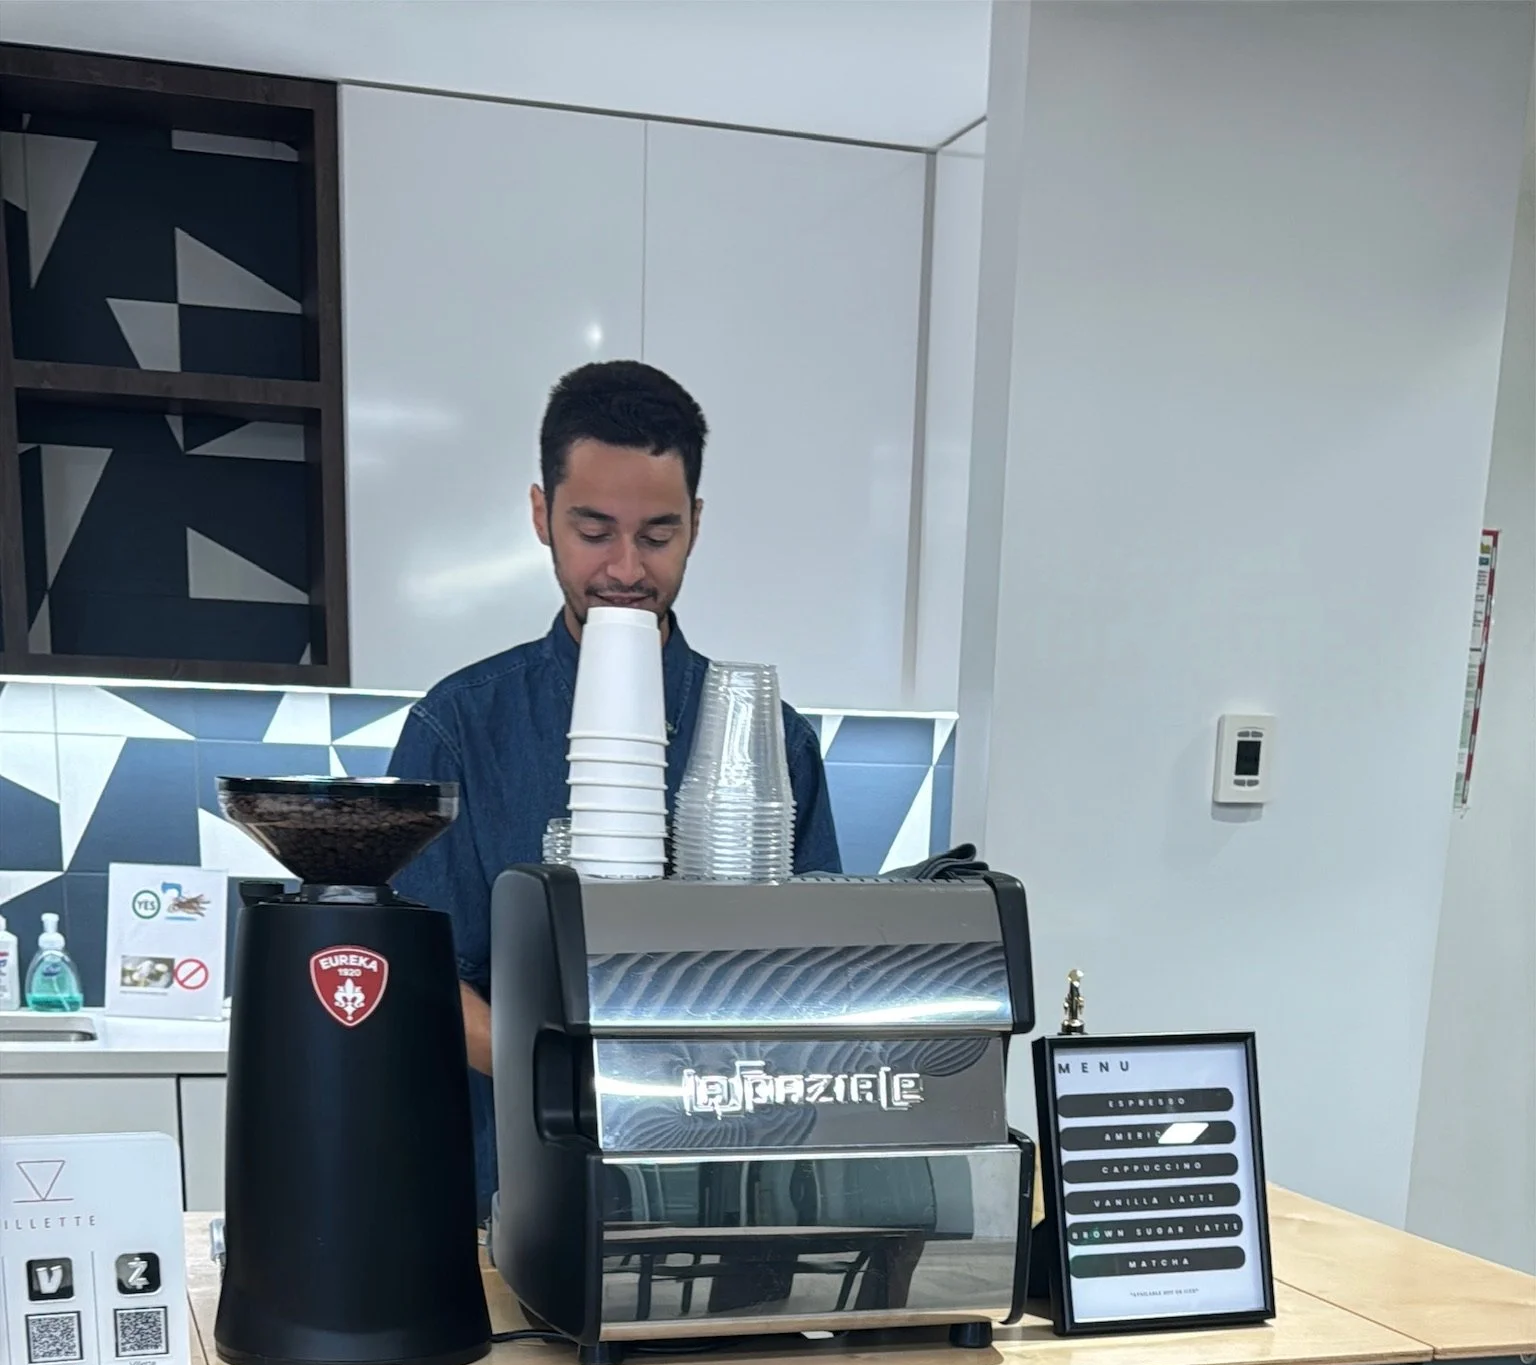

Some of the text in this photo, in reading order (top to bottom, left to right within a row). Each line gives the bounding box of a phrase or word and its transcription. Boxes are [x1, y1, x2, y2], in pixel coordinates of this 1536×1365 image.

[137, 900, 156, 911] YES
[319, 954, 378, 973] EUREKA
[1058, 1060, 1130, 1074] MENU
[1108, 1097, 1186, 1108] ESPRESSO
[1104, 1129, 1194, 1141] AMERIC
[1102, 1161, 1202, 1174] CAPPUCCINO
[1094, 1194, 1214, 1207] VANILLA LATTE
[0, 1215, 96, 1230] ILLETTE
[1072, 1223, 1239, 1239] BROWN SUGAR LATTE
[1129, 1258, 1190, 1268] MATCHA
